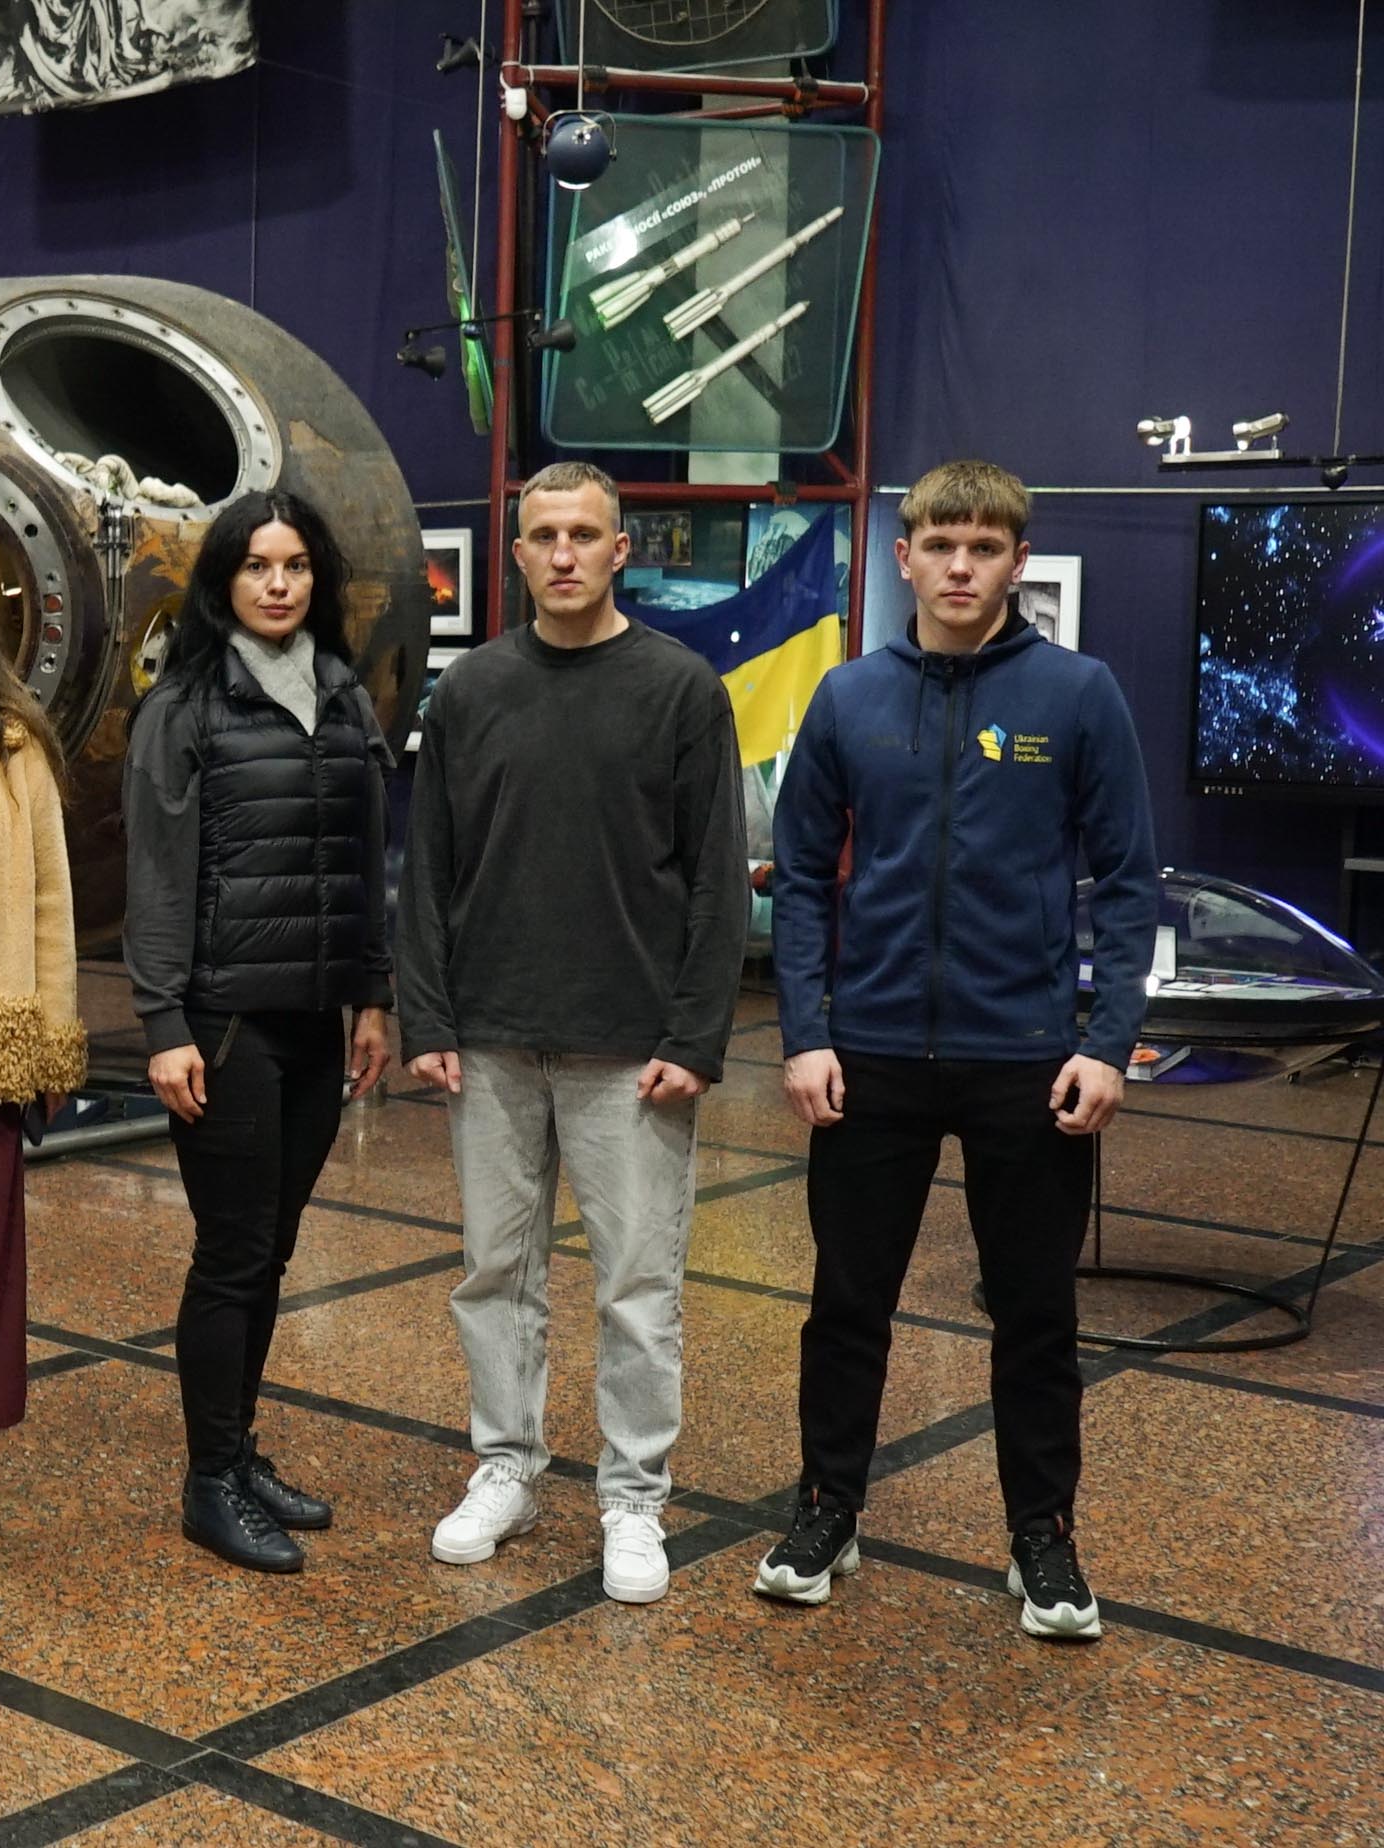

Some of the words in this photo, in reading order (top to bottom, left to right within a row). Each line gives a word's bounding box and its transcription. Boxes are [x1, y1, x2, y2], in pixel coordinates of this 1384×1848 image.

[708, 156, 762, 193] «ПРОТОН»
[1014, 734, 1049, 743] Ukrainian
[1014, 744, 1040, 754] Boxing
[1014, 754, 1053, 763] Federation
